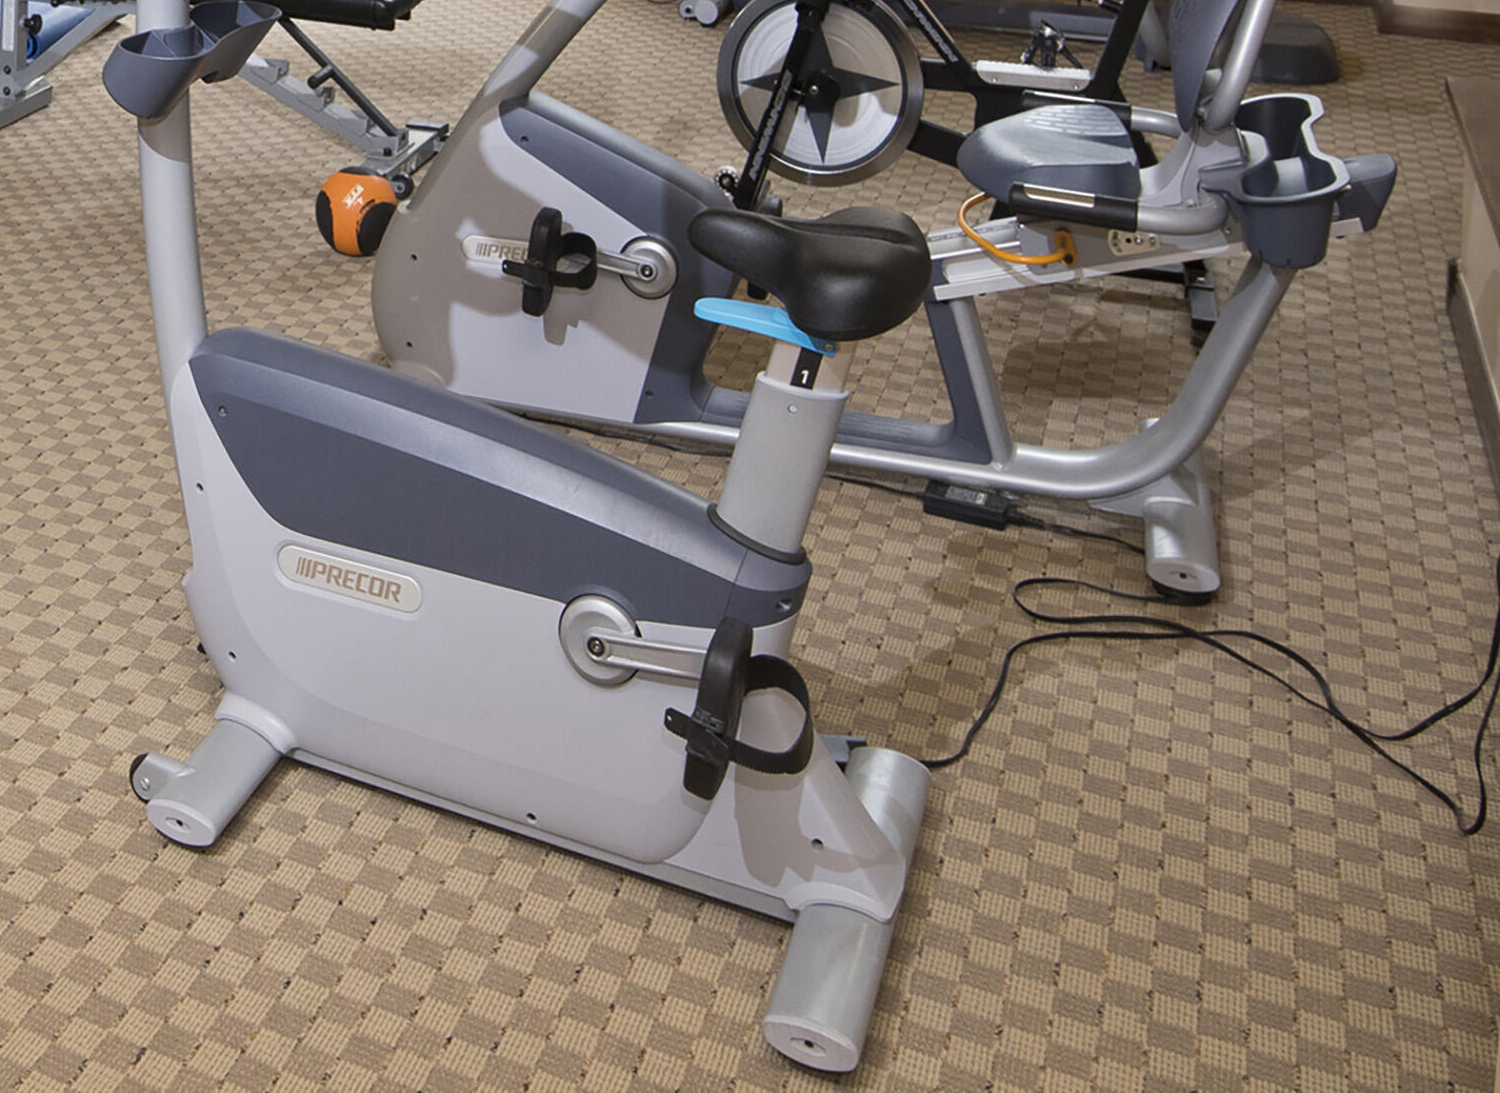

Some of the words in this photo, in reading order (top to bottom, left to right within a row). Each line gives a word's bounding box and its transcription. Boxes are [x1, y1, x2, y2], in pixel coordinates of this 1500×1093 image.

[487, 244, 529, 261] PREC
[801, 369, 809, 385] 1
[310, 561, 402, 603] PRECOR
